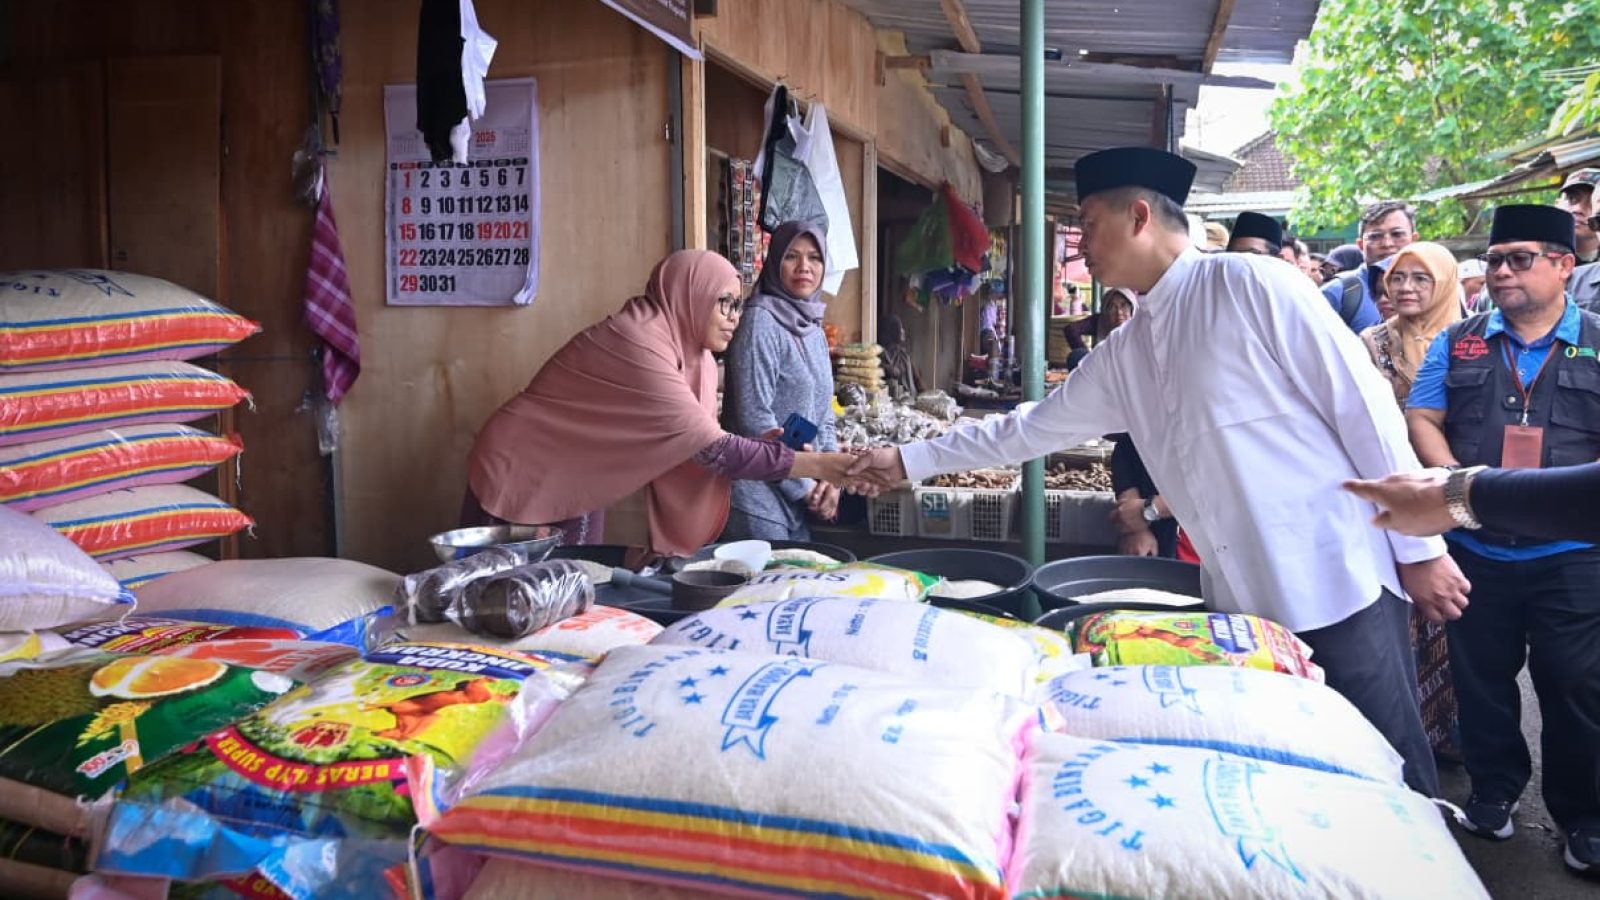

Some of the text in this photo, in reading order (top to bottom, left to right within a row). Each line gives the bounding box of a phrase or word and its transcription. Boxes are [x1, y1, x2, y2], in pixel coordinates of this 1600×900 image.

[404, 168, 524, 188] 1 2 3 4 5 6 7
[402, 194, 528, 214] 8 9 10 11 12 13 14
[399, 221, 529, 240] 15 16 17 18 19 20 21
[400, 248, 528, 266] 22 23 24 25 26 27 28
[400, 275, 455, 291] 29 30 31
[397, 655, 488, 673] KUDA
[217, 736, 266, 773] SUPER
[315, 764, 390, 786] BERAS
[1063, 798, 1145, 852] TIGA
